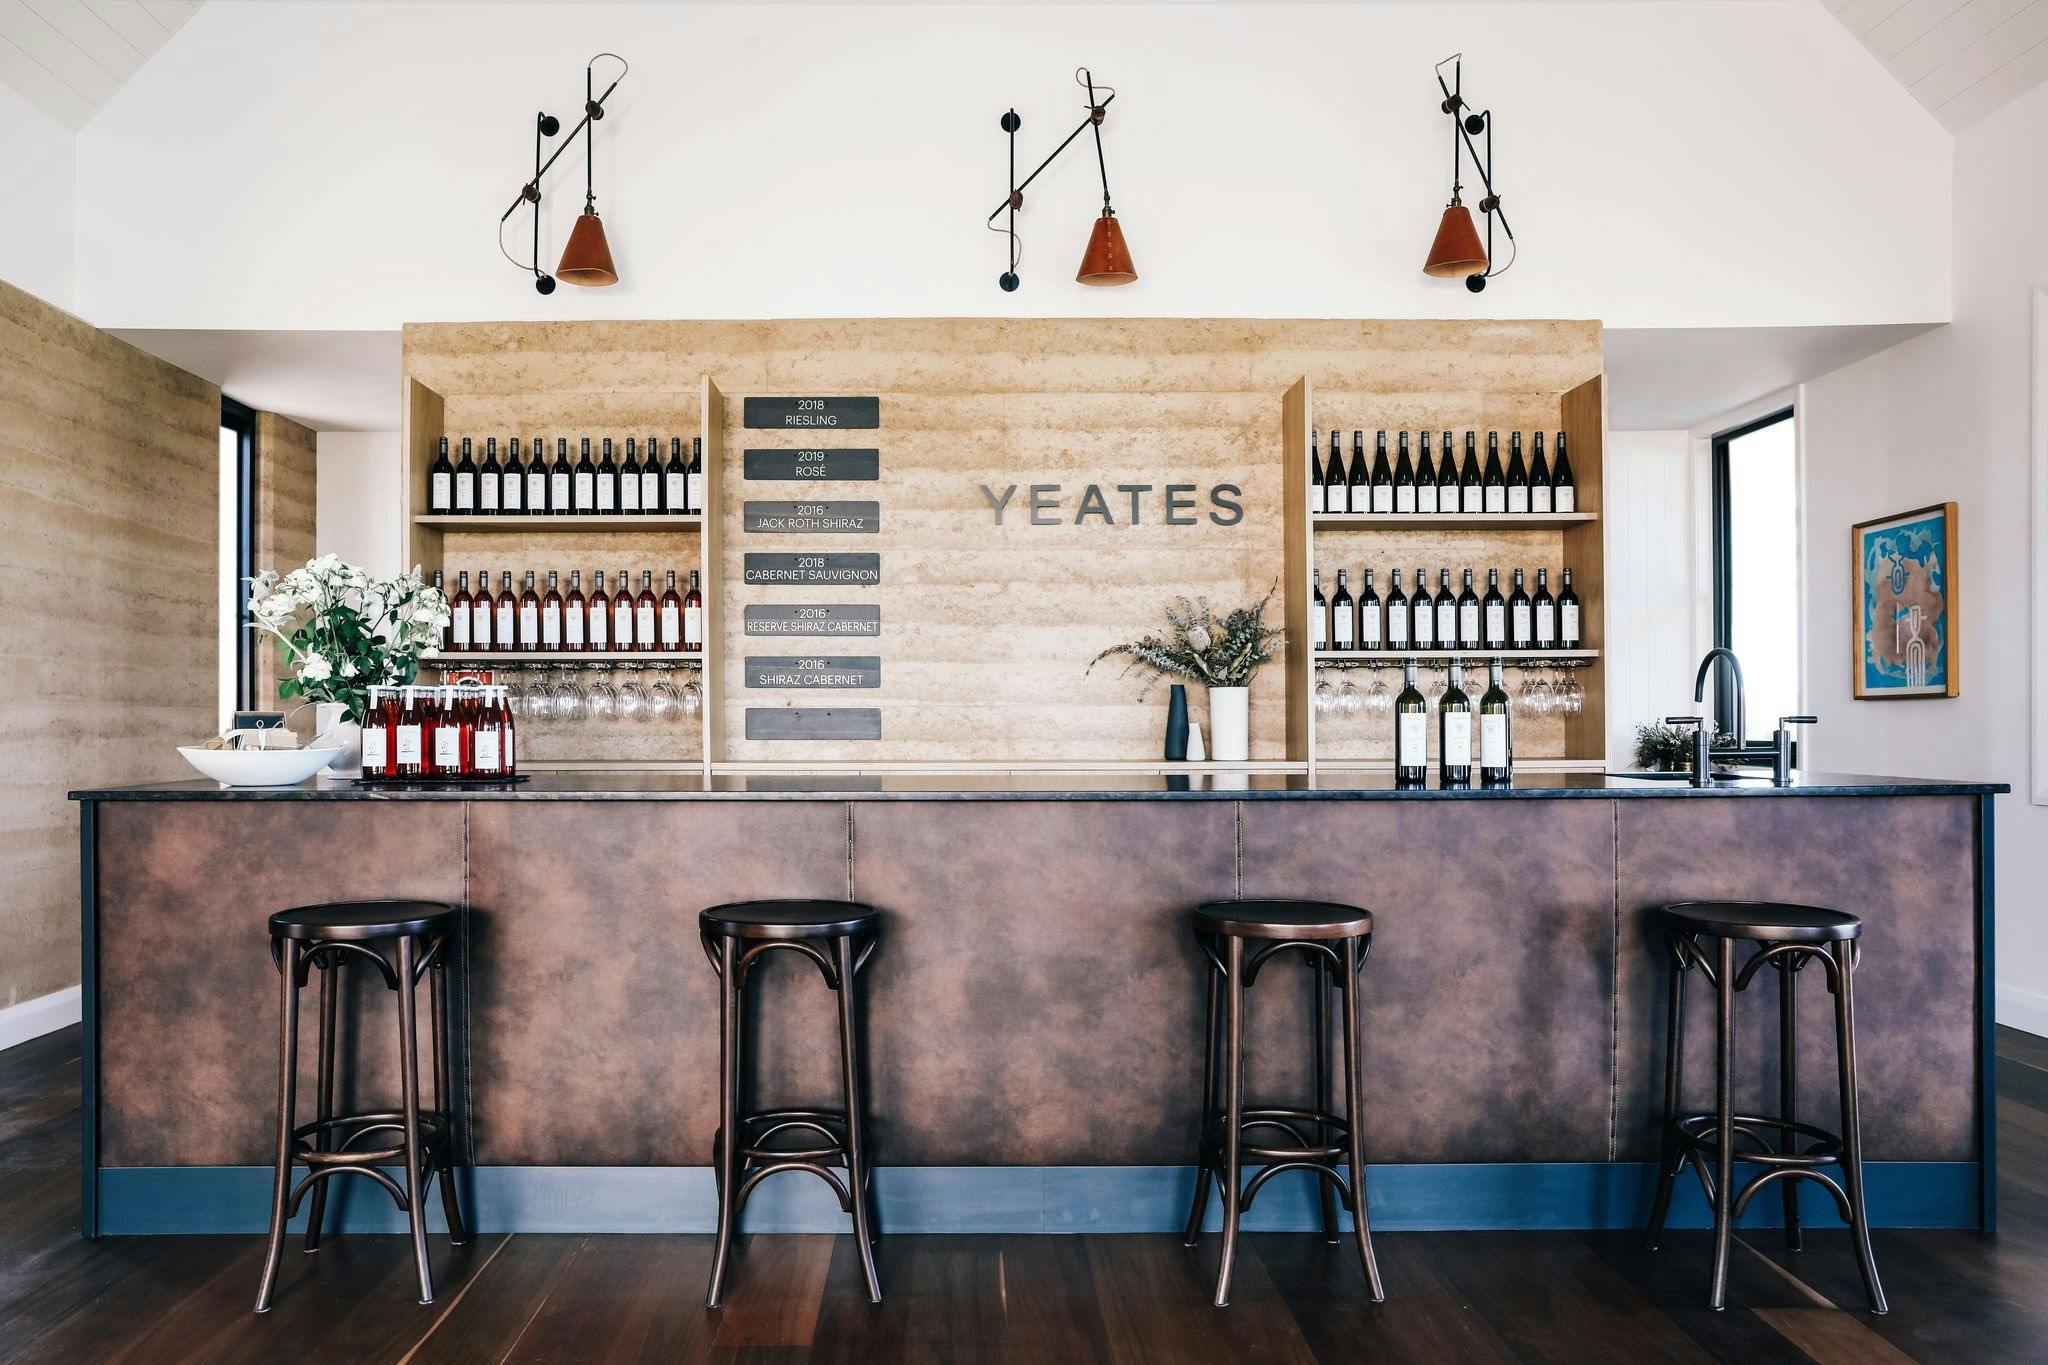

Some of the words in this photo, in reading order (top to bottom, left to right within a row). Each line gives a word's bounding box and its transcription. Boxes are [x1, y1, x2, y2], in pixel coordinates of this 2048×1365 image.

[798, 400, 825, 410] 2018
[785, 415, 837, 426] RIESLING
[798, 451, 824, 462] 2019
[795, 464, 826, 477] ROSÉ
[797, 505, 824, 515] 2016
[979, 483, 1244, 527] YEATES
[757, 518, 785, 528] JACK
[788, 518, 820, 528] ROTH
[822, 518, 864, 528] SHIRAZ
[798, 557, 825, 568] 2018
[745, 570, 806, 580] CABERNET
[808, 570, 878, 580] SAUVIGNON
[799, 608, 826, 619] 2016
[747, 621, 788, 632] RESERVE
[790, 621, 826, 632] SHIRAZ
[827, 621, 878, 632] CABERNET
[798, 660, 825, 670] 2016
[759, 675, 801, 685] SHIRAZ
[803, 675, 864, 685] CABERNET
